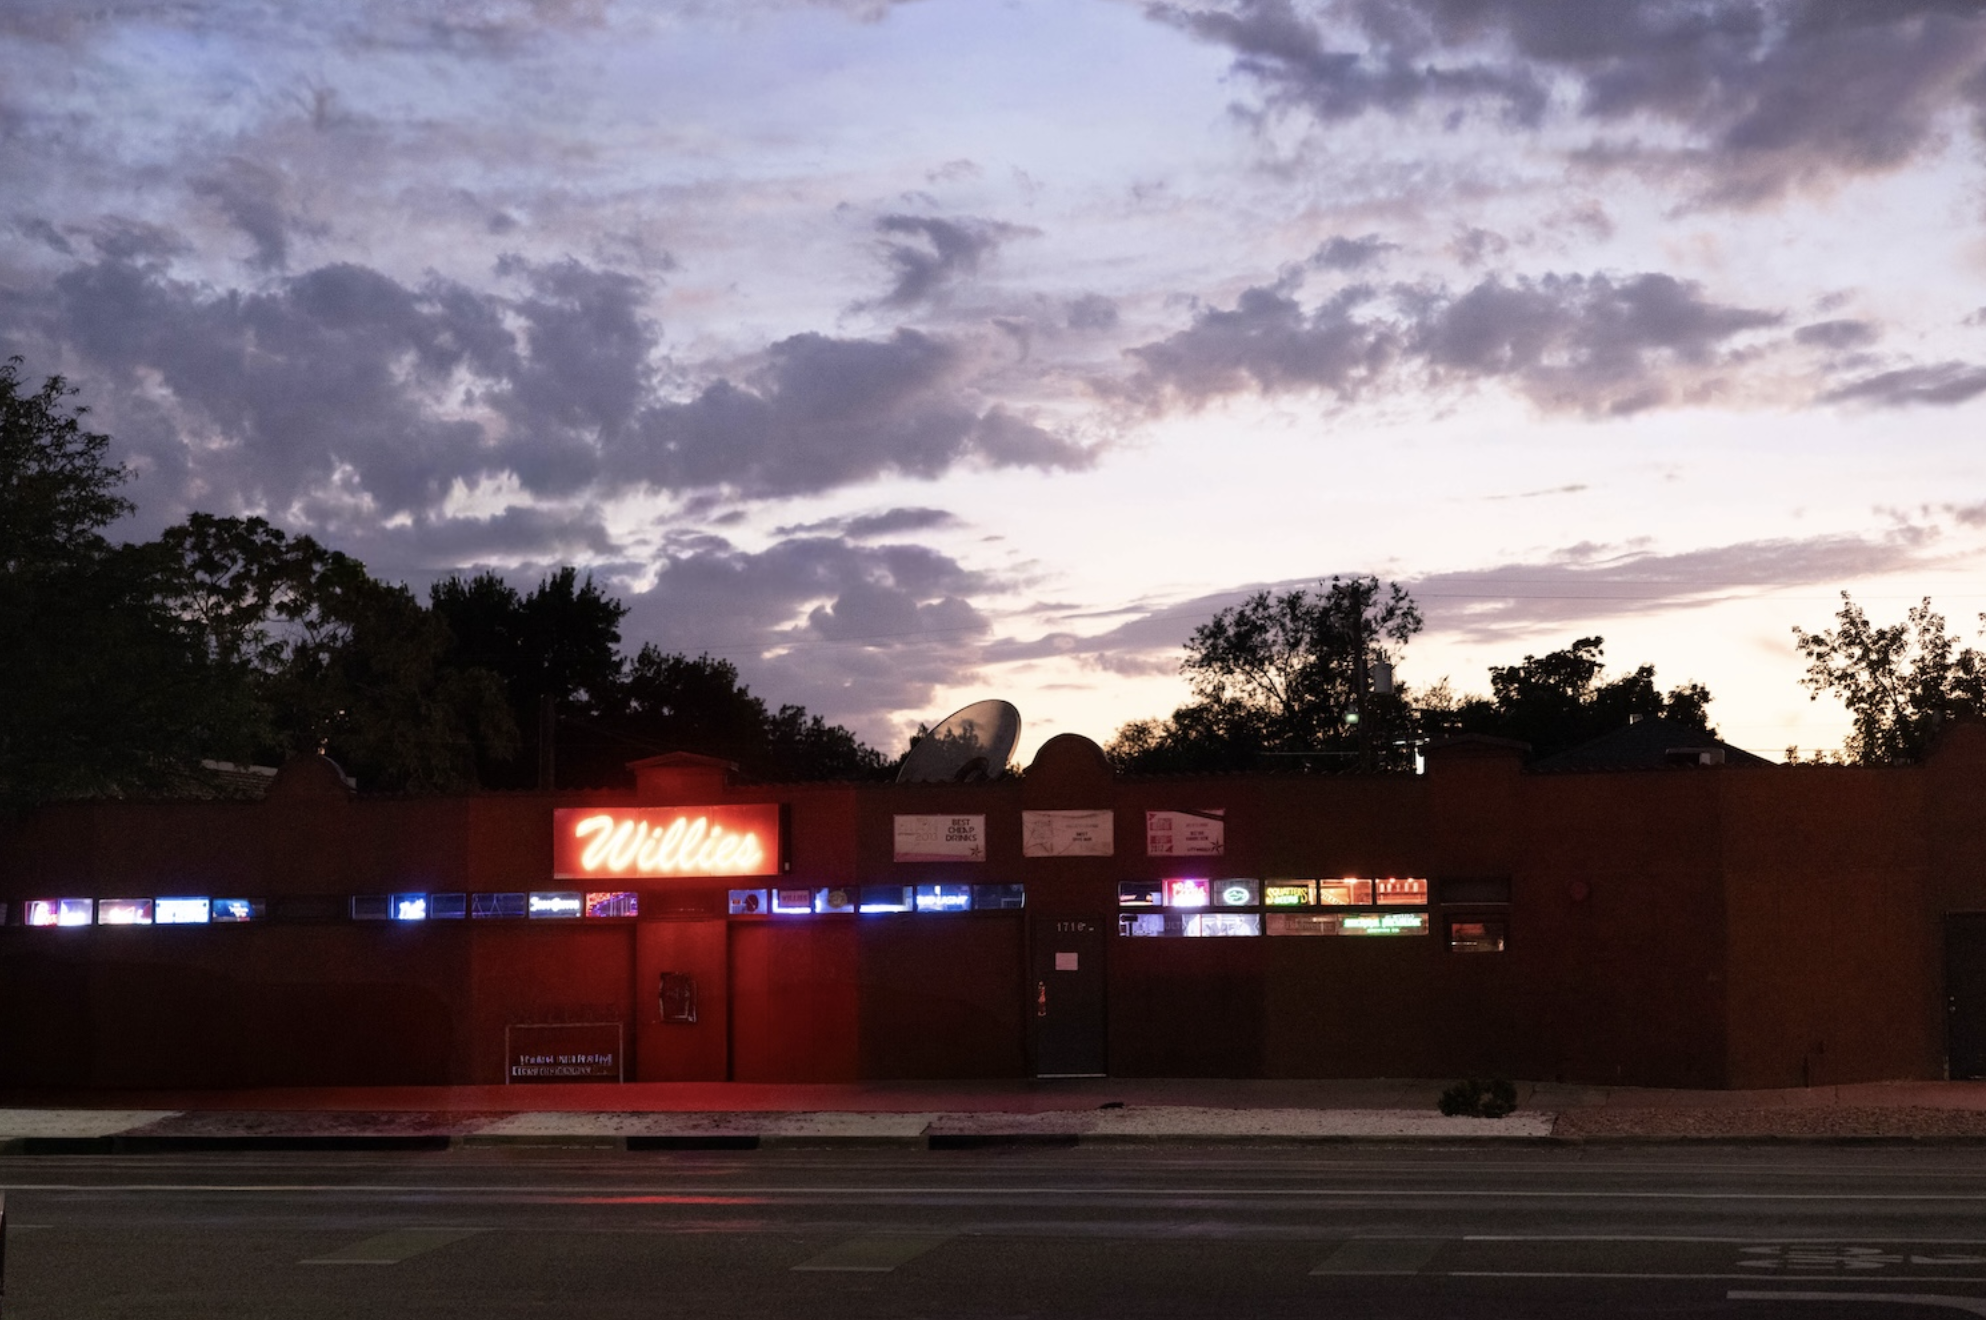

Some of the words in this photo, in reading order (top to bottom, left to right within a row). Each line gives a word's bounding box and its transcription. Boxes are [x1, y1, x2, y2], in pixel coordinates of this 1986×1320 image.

[951, 818, 971, 826] BEST
[947, 826, 975, 834] CHEAP
[945, 834, 978, 842] DRINKS
[575, 814, 763, 871] Willies
